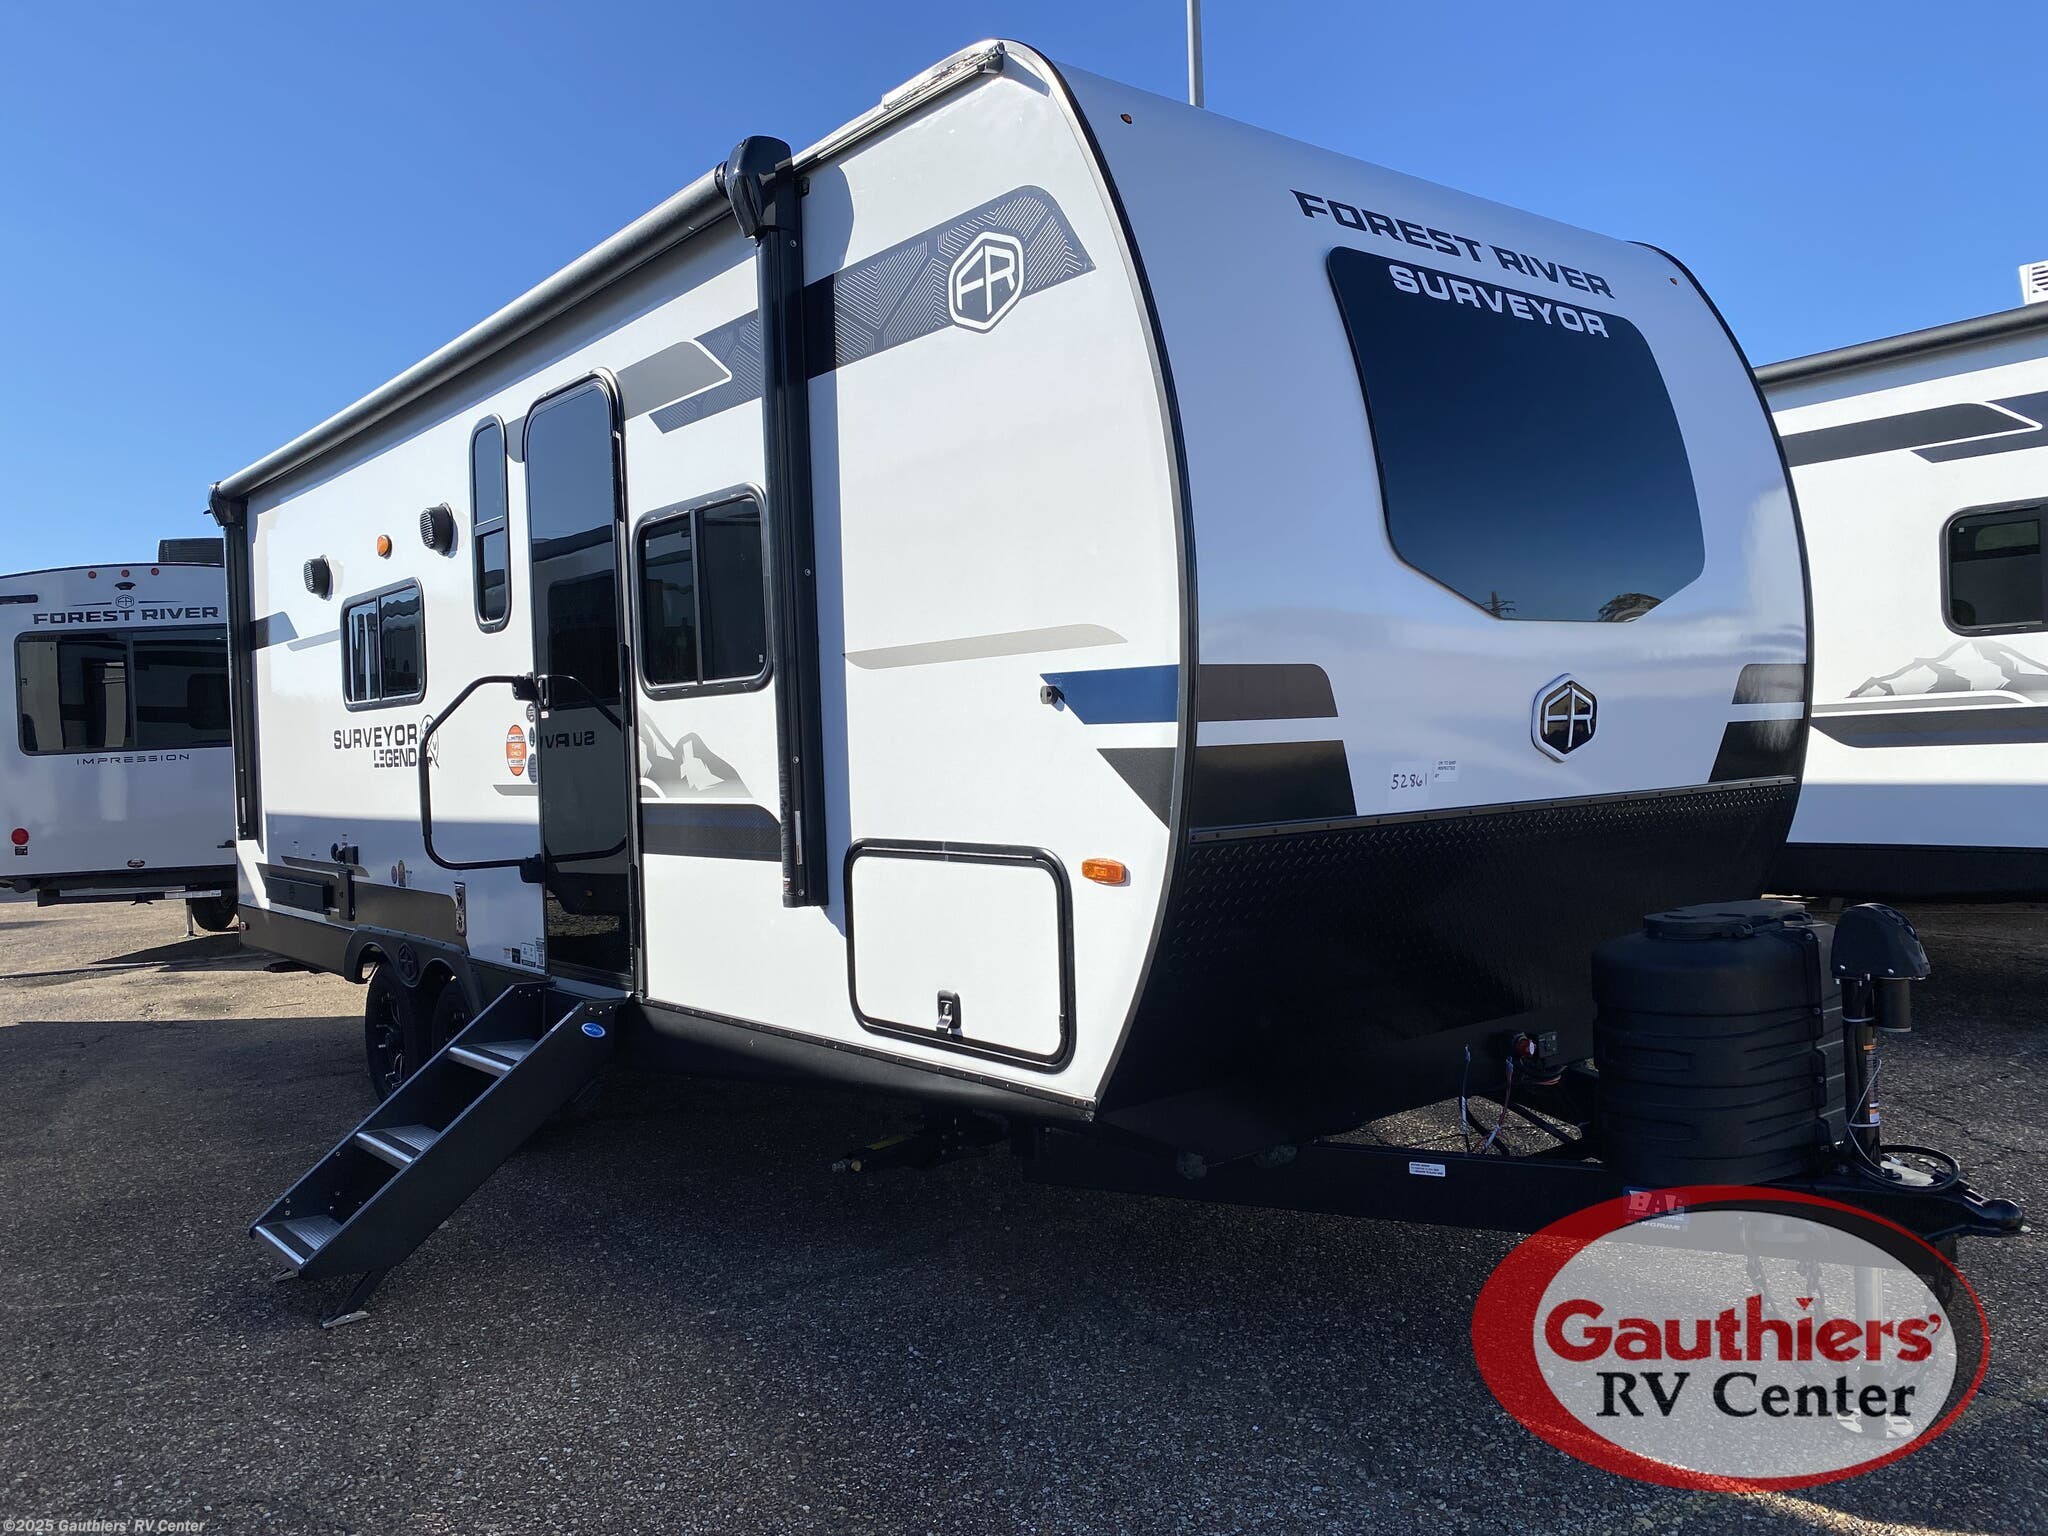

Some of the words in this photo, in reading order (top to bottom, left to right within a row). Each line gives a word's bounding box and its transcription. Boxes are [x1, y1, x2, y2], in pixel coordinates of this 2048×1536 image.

[1290, 189, 1482, 263] FOREST
[1489, 244, 1616, 300] RIVER
[1389, 265, 1609, 338] SURVEYOR
[32, 609, 135, 625] FOREST
[141, 606, 219, 621] RIVER
[333, 723, 418, 750] SURVEYOR
[76, 753, 191, 766] IMPRESSION
[373, 748, 418, 768] LEGEND
